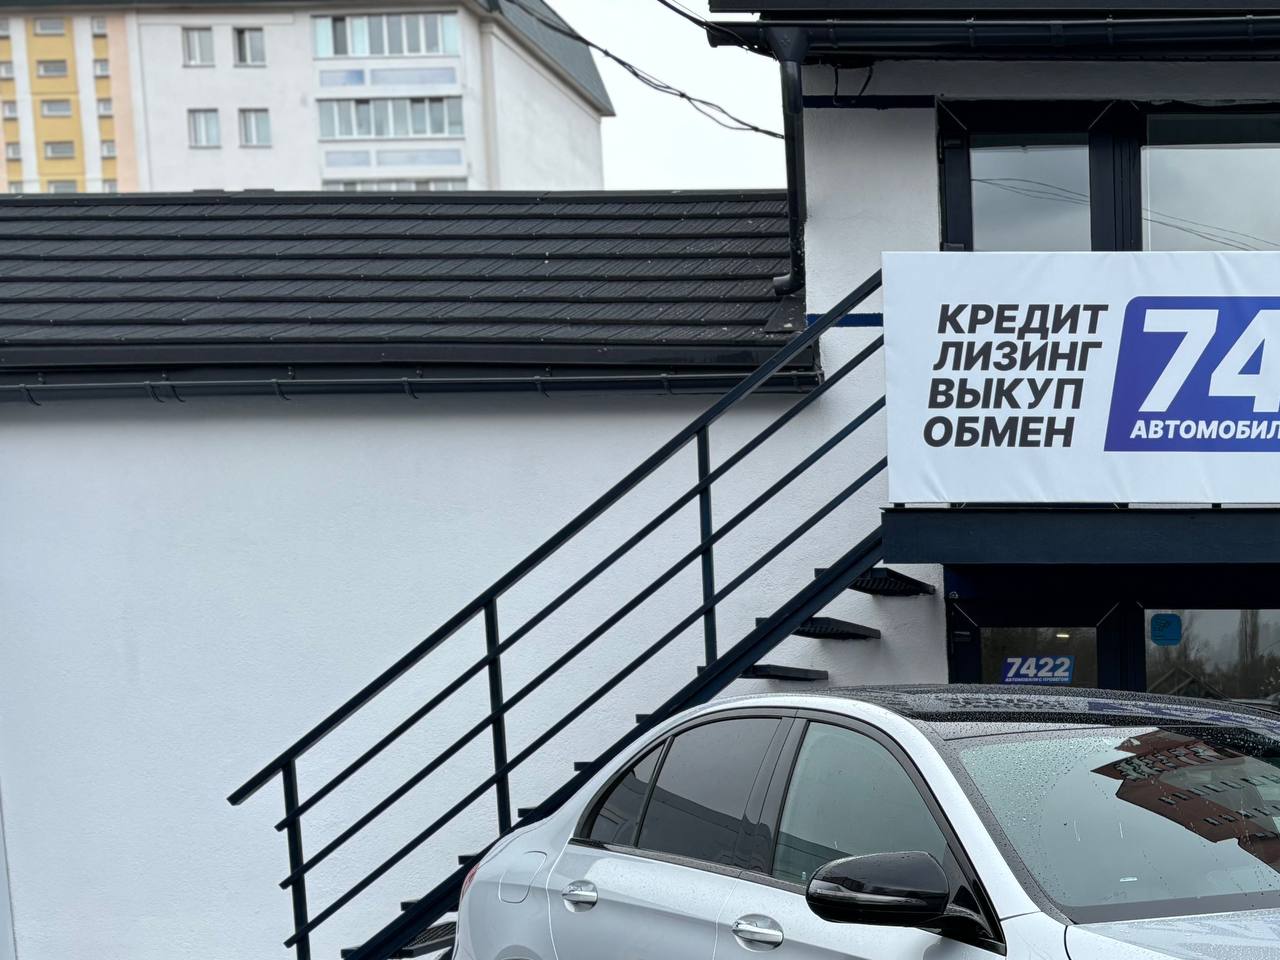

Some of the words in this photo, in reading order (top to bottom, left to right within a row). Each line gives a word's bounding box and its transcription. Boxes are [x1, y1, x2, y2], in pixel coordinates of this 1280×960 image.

[936, 303, 1109, 337] КРЕДИТ
[932, 341, 1103, 373] ЛИЗИНГ
[927, 377, 1084, 410] ВЫКУП
[922, 415, 1076, 449] ОБМЕН
[1007, 657, 1071, 677] 7422
